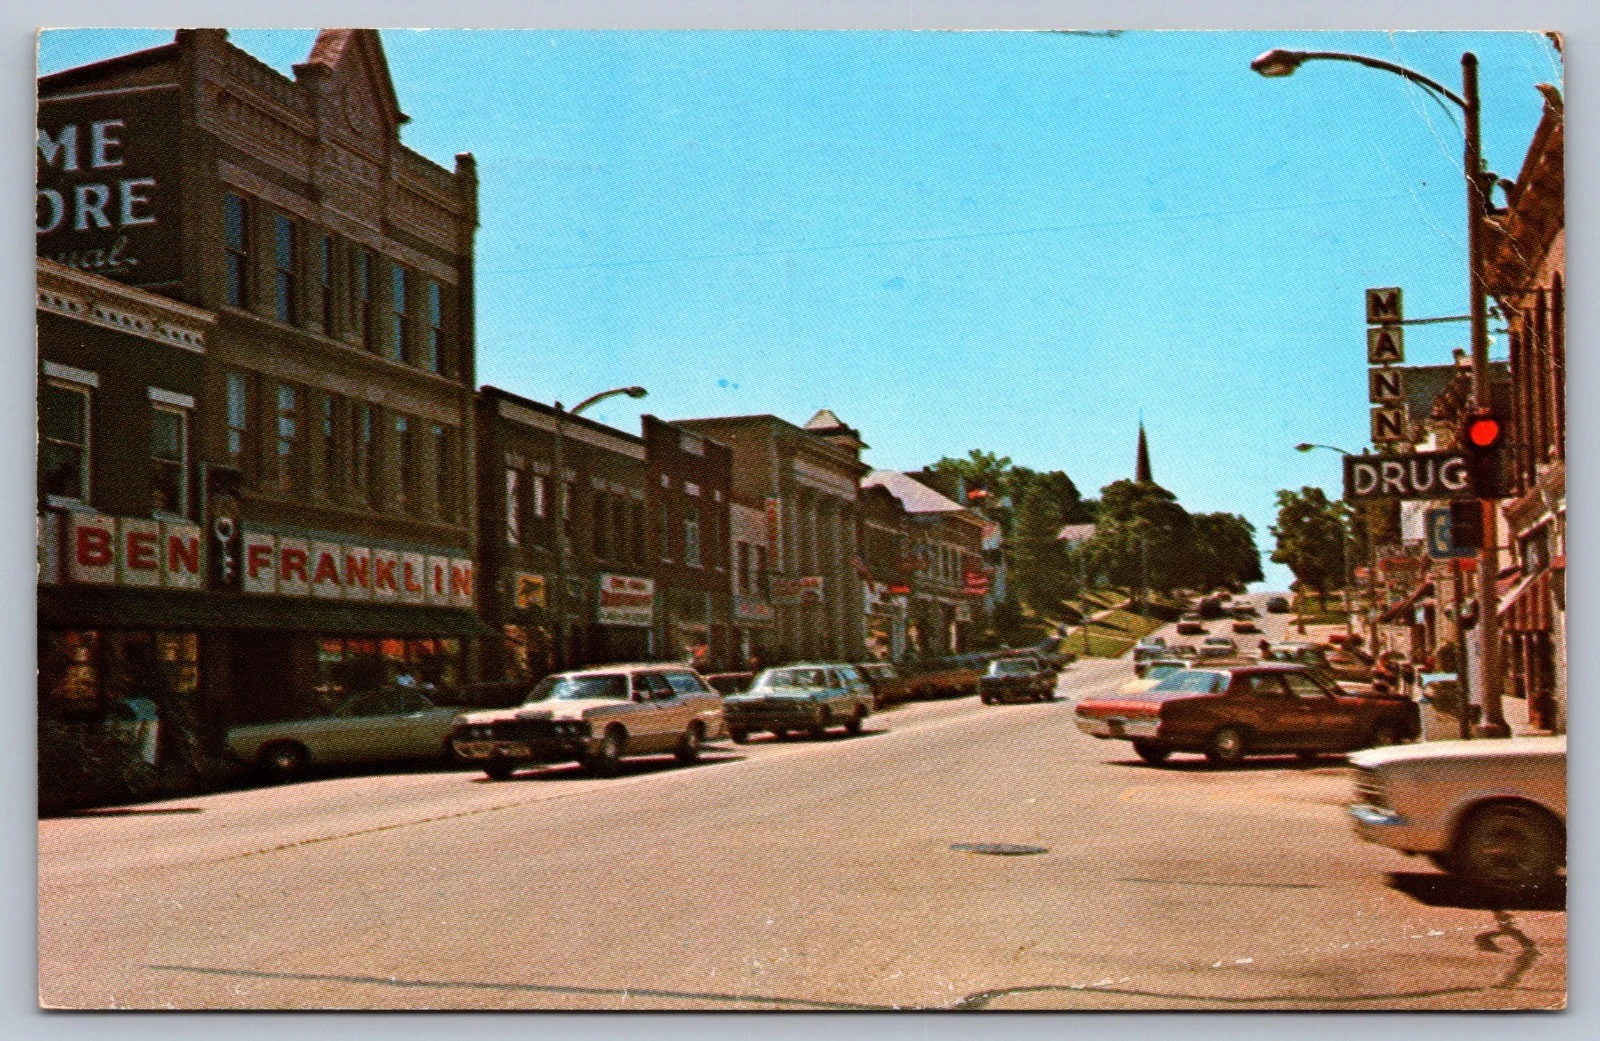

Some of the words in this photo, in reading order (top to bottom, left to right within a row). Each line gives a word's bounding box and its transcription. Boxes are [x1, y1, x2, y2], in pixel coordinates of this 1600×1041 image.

[1371, 291, 1403, 437] MANN
[1354, 457, 1469, 495] DRUG
[76, 525, 199, 574] BEN
[246, 543, 473, 598] FRANKLIN
